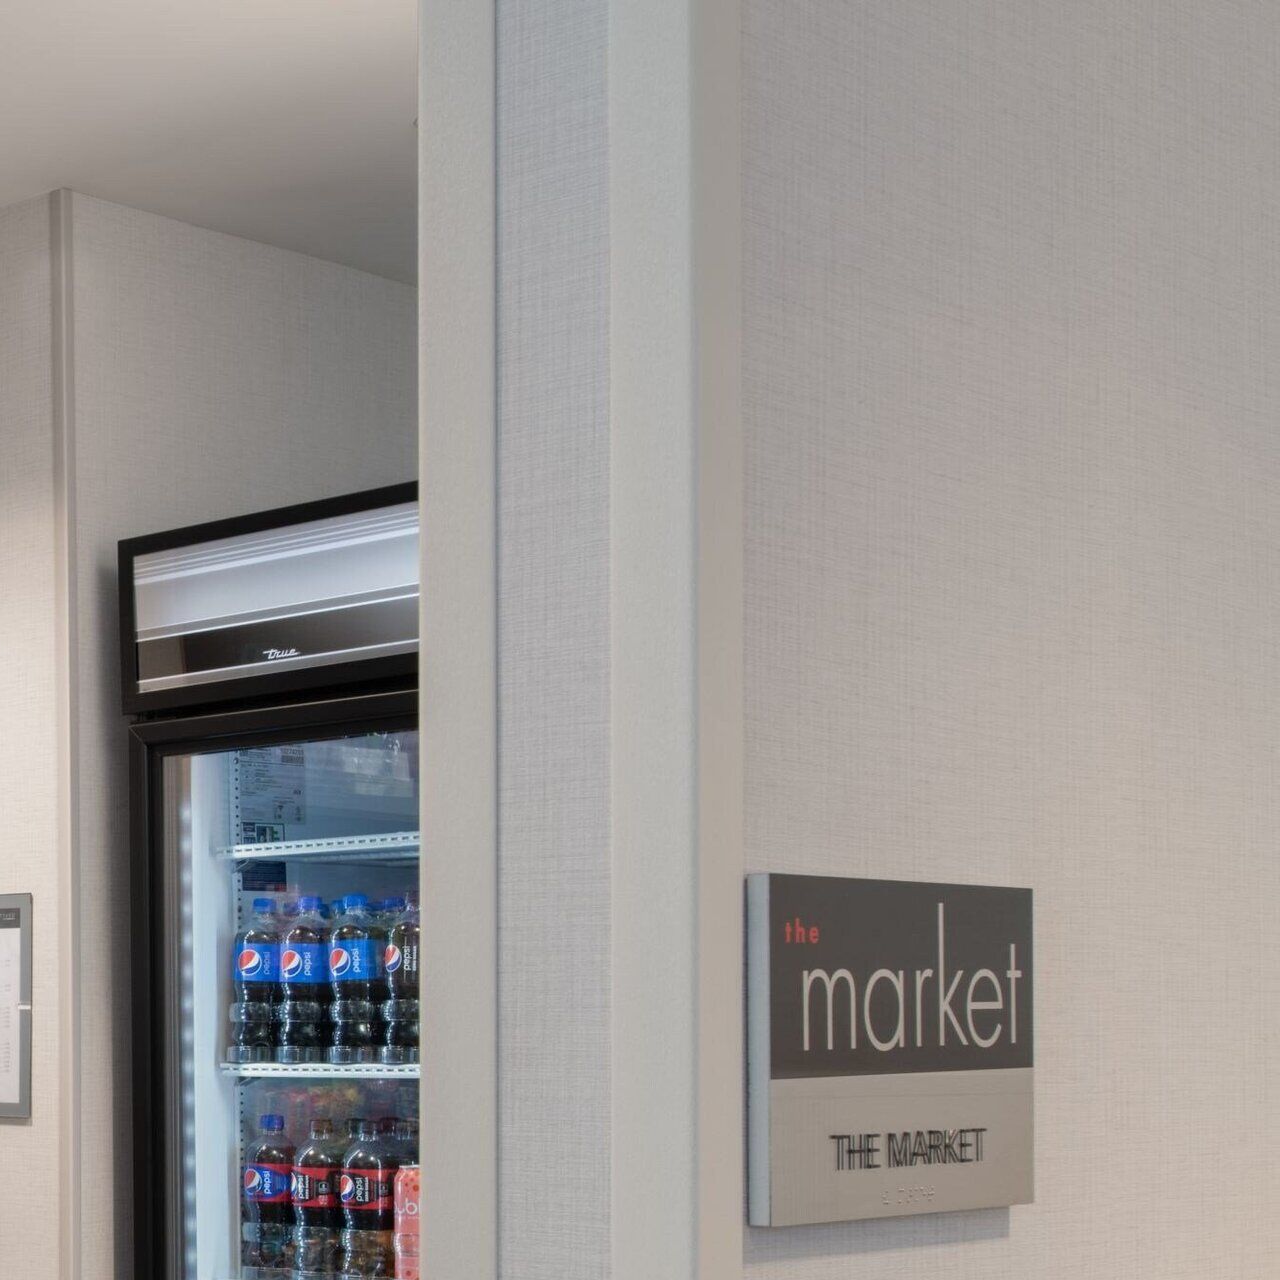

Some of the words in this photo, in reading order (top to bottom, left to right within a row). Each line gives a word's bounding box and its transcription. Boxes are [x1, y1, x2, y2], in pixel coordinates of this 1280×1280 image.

[785, 919, 819, 943] the
[303, 952, 312, 975] pepsi
[352, 948, 361, 973] pepsi
[403, 946, 411, 971] pepsi
[803, 902, 1022, 1051] market
[829, 1133, 882, 1171] THE
[887, 1128, 987, 1168] MARKET
[264, 1171, 272, 1194] pepsi
[356, 1178, 364, 1201] pepsi
